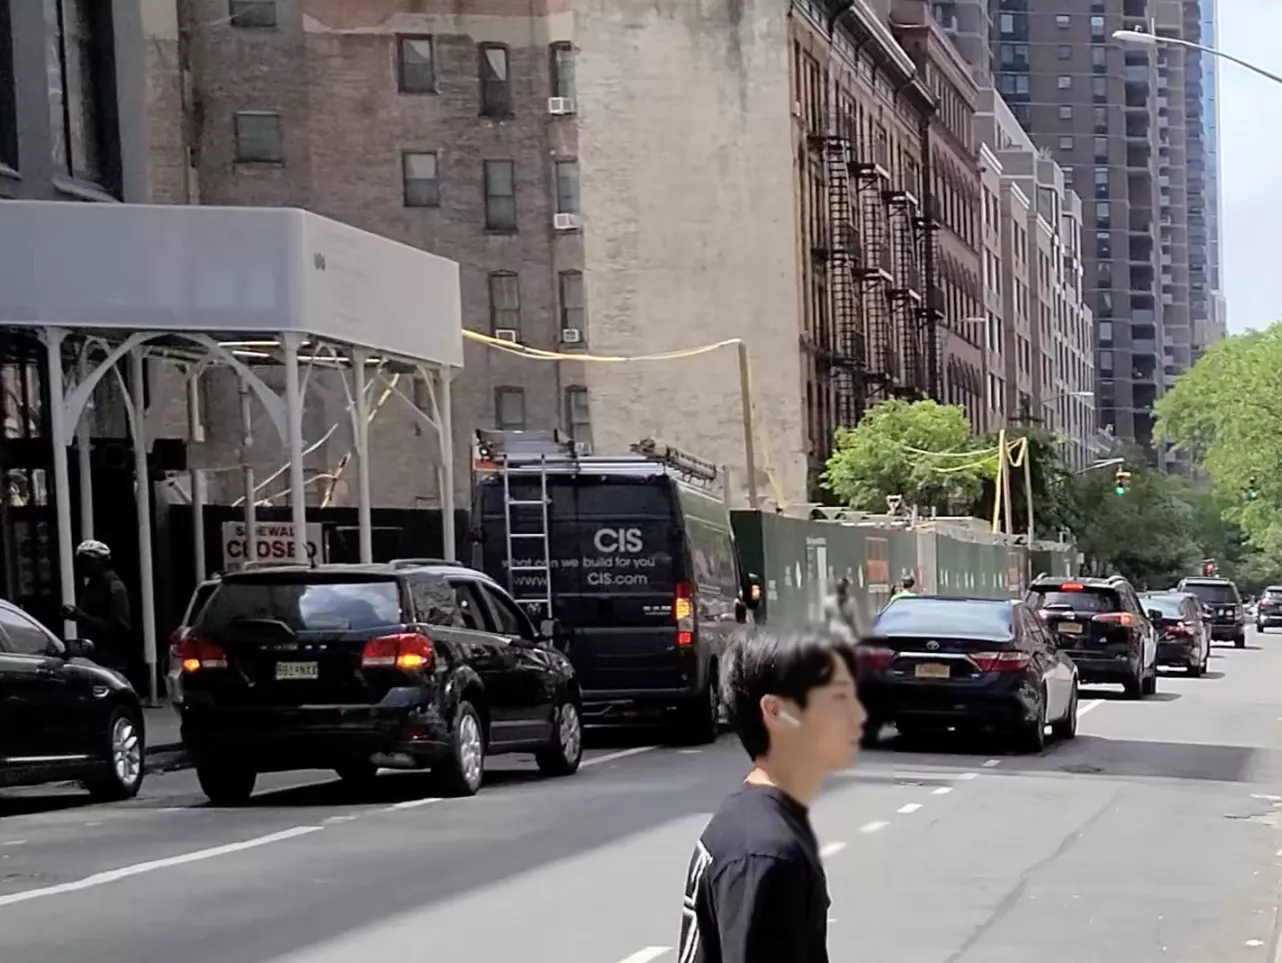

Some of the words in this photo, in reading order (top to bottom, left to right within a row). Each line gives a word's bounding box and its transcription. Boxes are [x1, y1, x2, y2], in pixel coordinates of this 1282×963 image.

[593, 528, 643, 552] CIS
[560, 558, 579, 567] we
[582, 556, 613, 568] build
[615, 556, 631, 567] for
[632, 557, 656, 569] you
[587, 572, 648, 585] CIS.com
